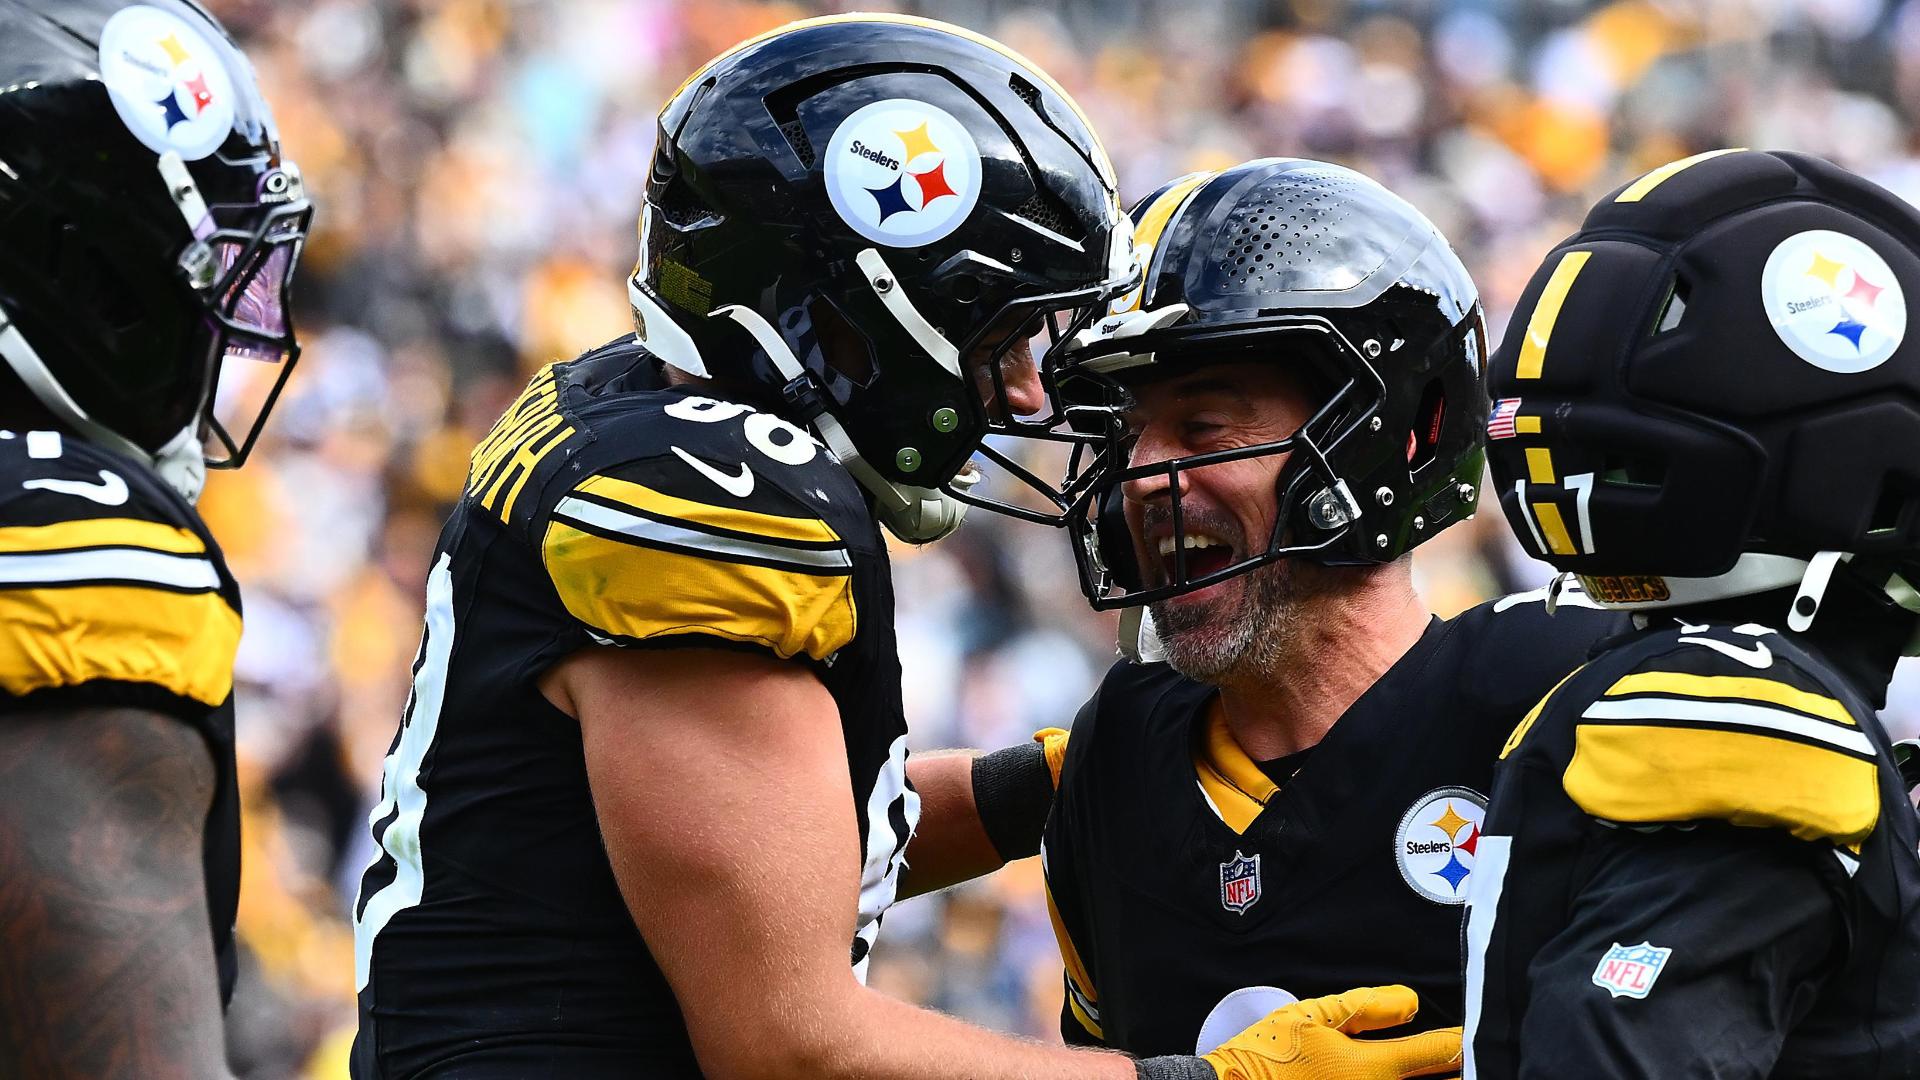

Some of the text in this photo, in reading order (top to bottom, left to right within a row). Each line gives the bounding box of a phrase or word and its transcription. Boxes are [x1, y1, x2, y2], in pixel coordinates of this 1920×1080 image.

[850, 140, 900, 171] Steelers
[1514, 472, 1595, 555] 17
[1406, 841, 1451, 855] Steelers
[1226, 878, 1255, 904] NFL
[1601, 960, 1646, 989] NFL
